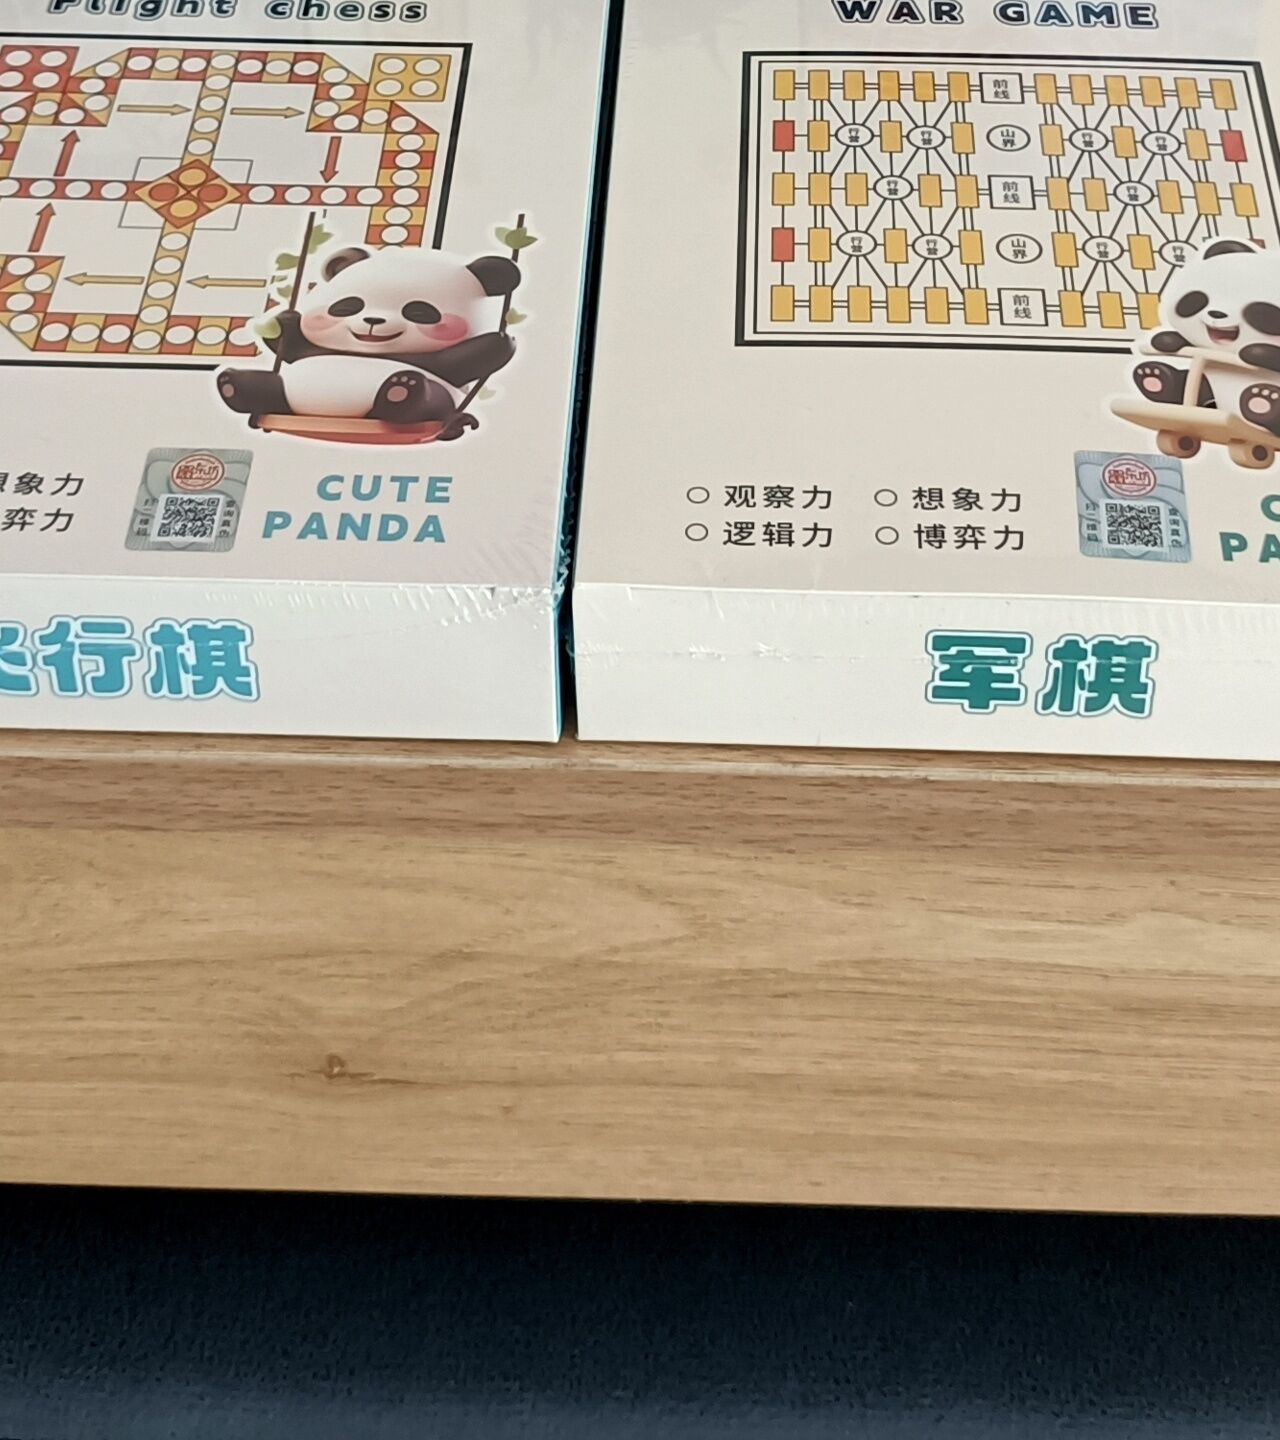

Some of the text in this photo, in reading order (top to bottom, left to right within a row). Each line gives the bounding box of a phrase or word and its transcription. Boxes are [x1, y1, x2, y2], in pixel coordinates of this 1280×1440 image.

[993, 0, 1159, 29] GAME
[993, 79, 1011, 100] 前线
[1002, 181, 1021, 204] 前线
[1012, 294, 1033, 320] 前线
[316, 475, 452, 502] CUTE
[724, 483, 1023, 513] 观察力 想象力
[262, 512, 447, 542] PANDA
[723, 520, 1026, 552] 逻辑力 博弈力
[924, 629, 1159, 720] 军棋
